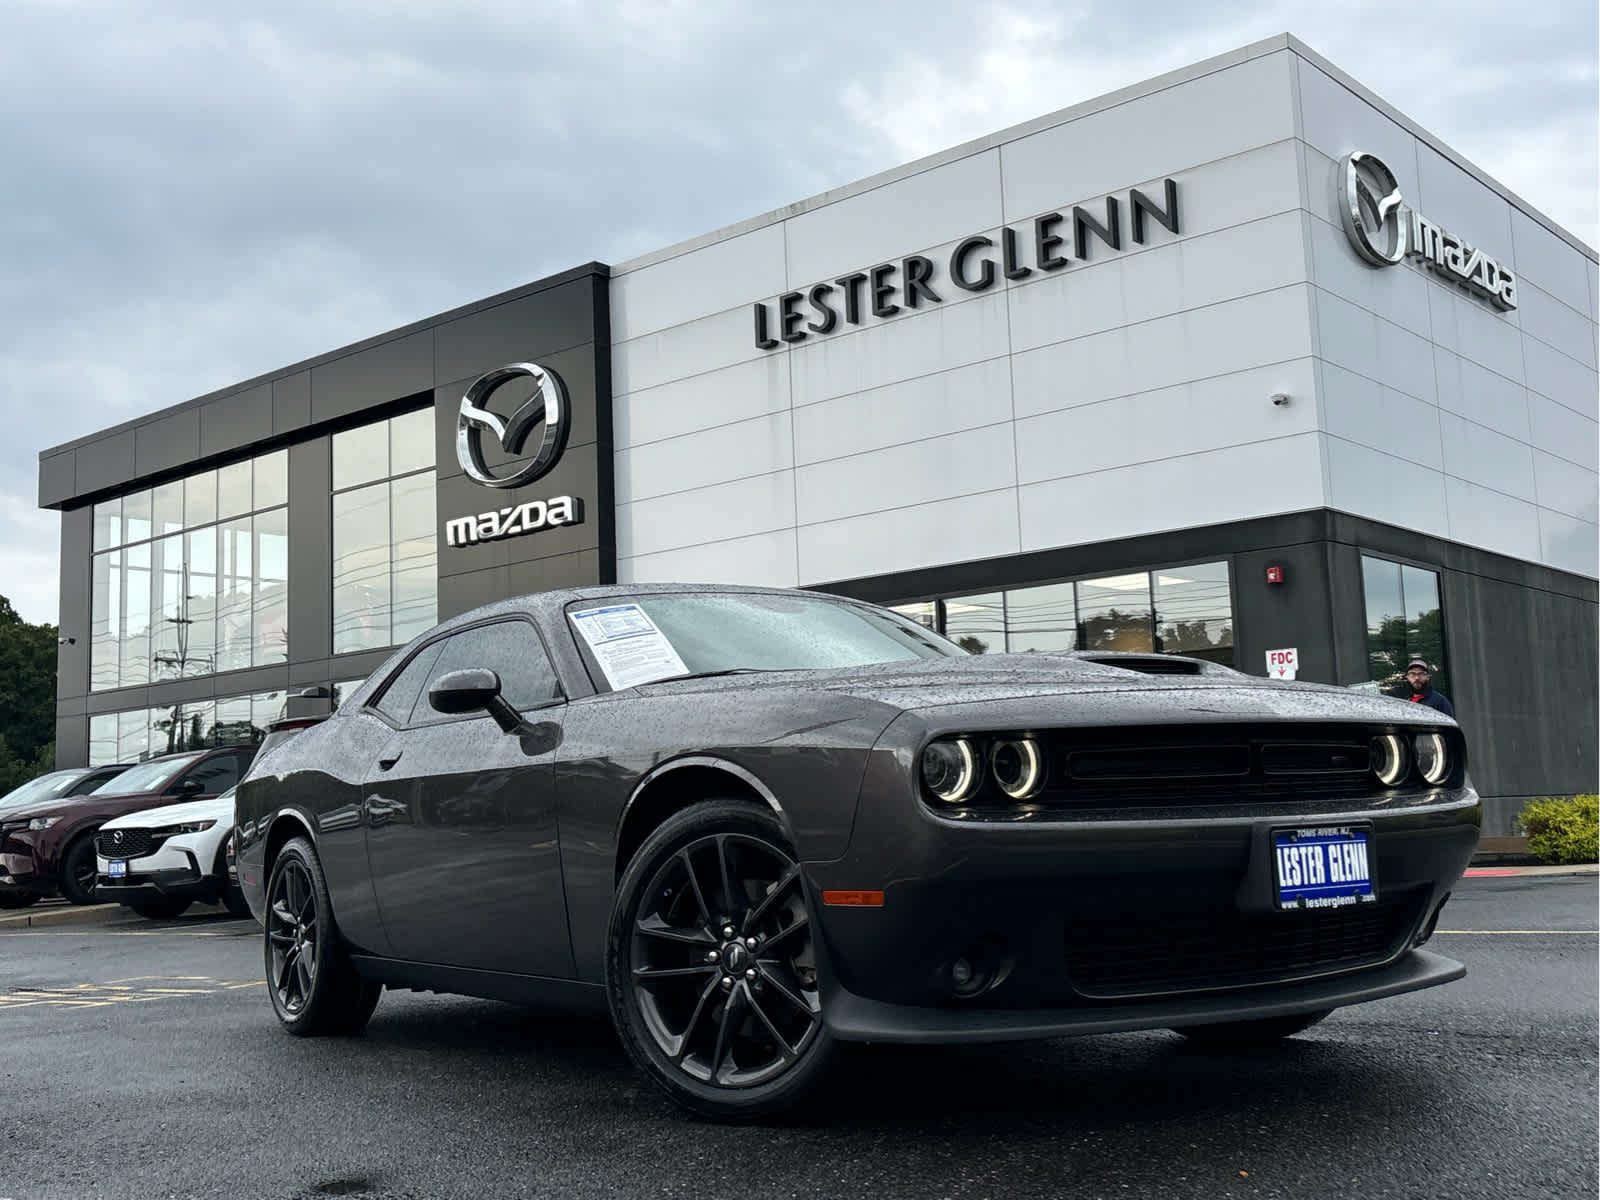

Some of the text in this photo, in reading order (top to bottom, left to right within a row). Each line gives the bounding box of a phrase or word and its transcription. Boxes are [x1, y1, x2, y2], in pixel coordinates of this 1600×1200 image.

[754, 178, 1180, 350] LESTER GLENN
[1271, 651, 1293, 665] FDC
[1277, 843, 1369, 887] LESTER GLENN
